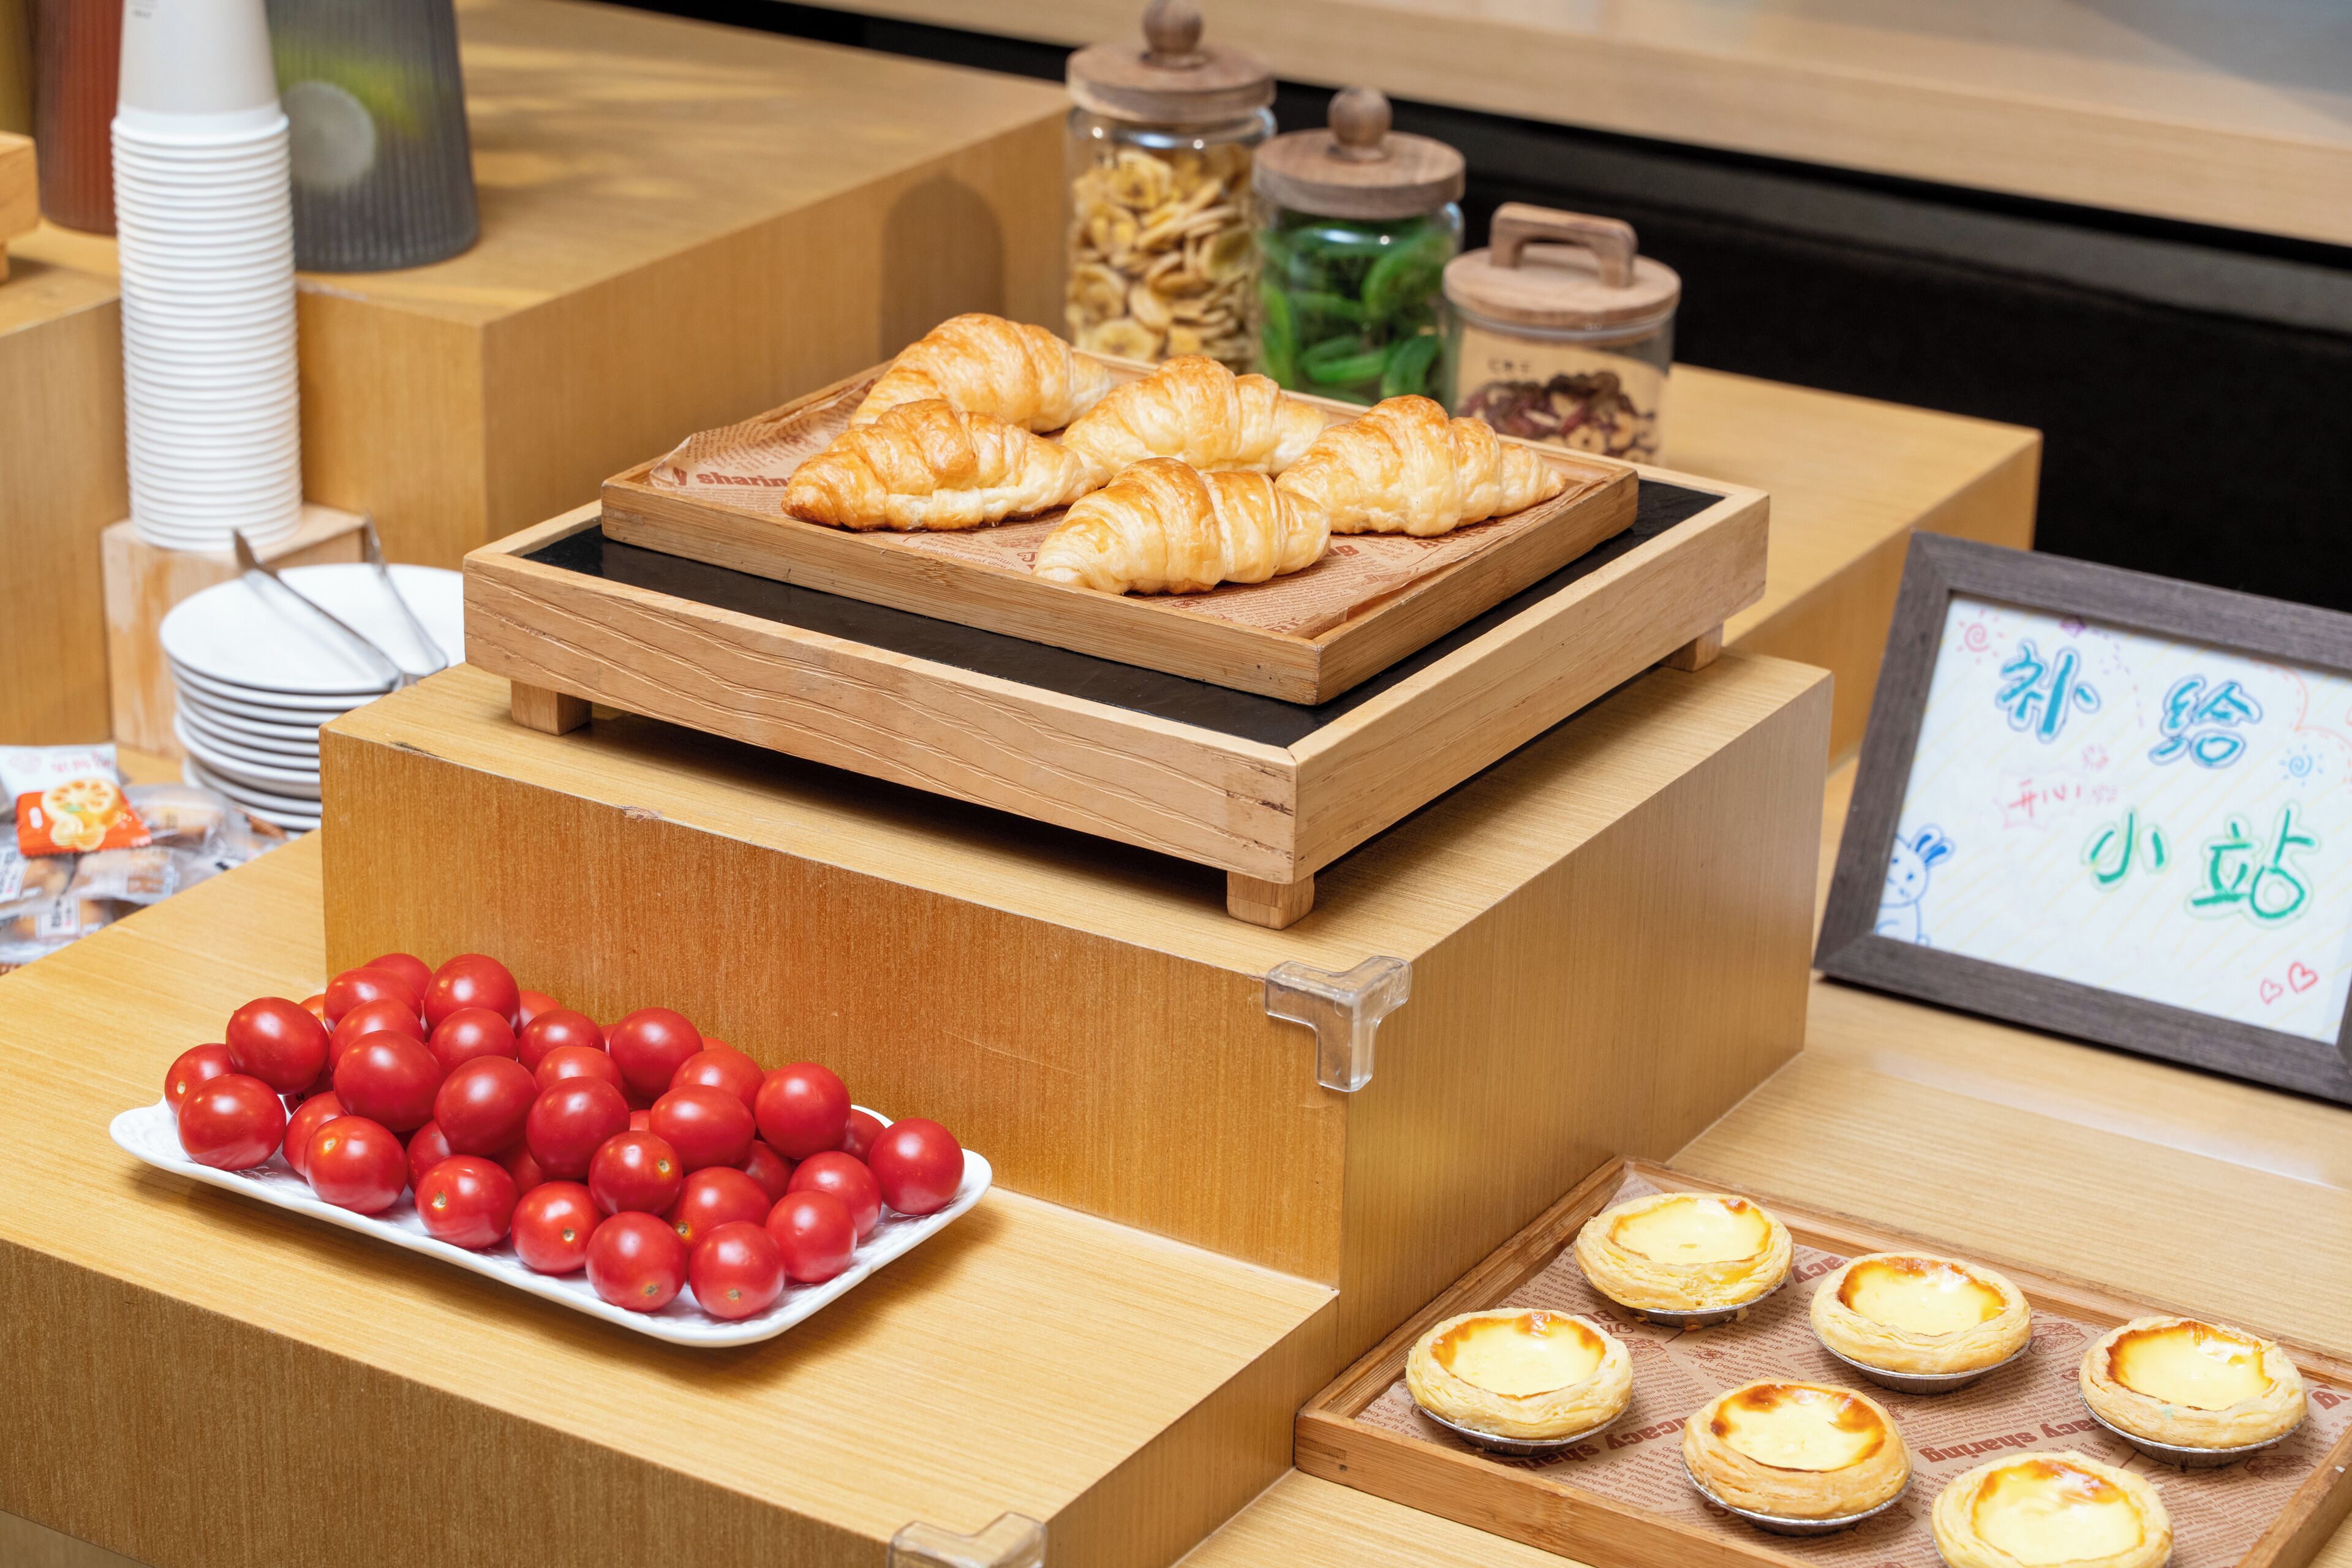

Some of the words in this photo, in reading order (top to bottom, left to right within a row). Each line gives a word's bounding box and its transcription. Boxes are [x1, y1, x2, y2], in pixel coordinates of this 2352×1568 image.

[696, 471, 792, 487] sharin
[1994, 639, 2263, 769] 补给
[2080, 802, 2319, 929] 小站
[1562, 1269, 1580, 1278] this
[1532, 1294, 1577, 1311] delicious
[1533, 1287, 1553, 1297] you
[1555, 1295, 1575, 1305] and
[1760, 1308, 1787, 1317] Cake
[1790, 1316, 1809, 1324] has
[1729, 1327, 1746, 1336] full
[1747, 1332, 1783, 1344] course
[1770, 1330, 1789, 1341] this
[1773, 1324, 1803, 1337] enjoy
[1707, 1334, 1728, 1343] and
[1713, 1330, 1748, 1341] expect
[1749, 1339, 1769, 1348] the
[1698, 1363, 1725, 1376] been
[1716, 1363, 1753, 1374] person
[1752, 1365, 1795, 1380] moment
[1669, 1400, 1697, 1409] delicious
[1384, 1415, 1406, 1424] and
[1918, 1431, 2038, 1463] sharing
[2093, 1441, 2116, 1452] dish
[1635, 1453, 1655, 1463] has
[1624, 1467, 1664, 1482] special
[1635, 1462, 1672, 1476] bakery
[1604, 1467, 1626, 1478] This
[1628, 1475, 1678, 1494] Delicious
[1918, 1480, 1936, 1489] full
[1575, 1473, 1613, 1488] proper
[1615, 1487, 1664, 1506] condition
[1600, 1490, 1623, 1500] and
[1602, 1474, 1625, 1485] fully
[1626, 1483, 1678, 1503] produced
